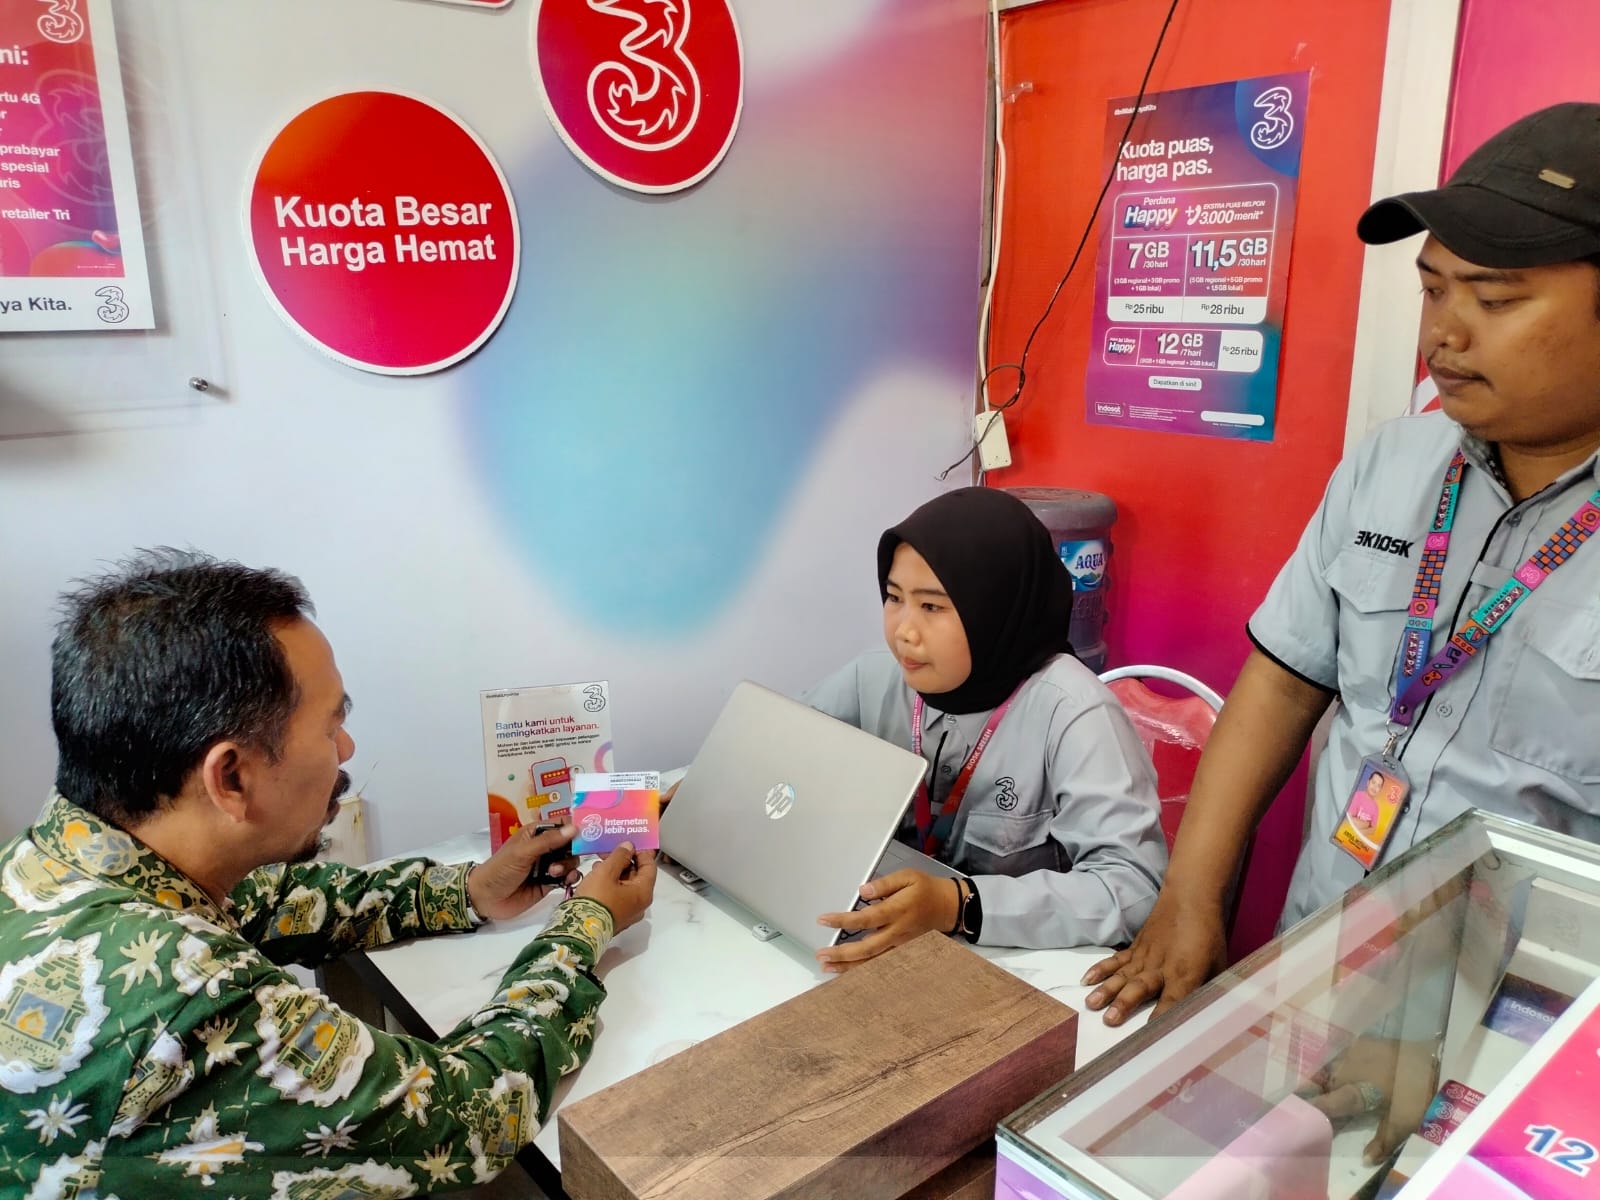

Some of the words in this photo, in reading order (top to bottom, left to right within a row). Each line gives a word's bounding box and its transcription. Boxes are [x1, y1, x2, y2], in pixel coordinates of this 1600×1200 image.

[21, 93, 41, 104] 4G
[0, 144, 60, 157] prabayar
[1168, 137, 1214, 159] puas,
[1, 162, 49, 173] spesial
[1116, 161, 1168, 183] harga
[1172, 158, 1212, 181] pas.
[2, 208, 50, 220] retailer
[52, 208, 70, 221] Tri
[274, 196, 386, 228] Kuota
[395, 195, 492, 227] Besar
[1124, 206, 1178, 226] Happy
[1199, 210, 1235, 225] 3.000
[281, 236, 386, 271] Harga
[395, 233, 496, 263] Hemat
[1144, 241, 1170, 258] GB
[1239, 237, 1268, 256] GB
[28, 297, 72, 311] Kita.
[1145, 304, 1164, 314] ribu
[1223, 304, 1245, 315] ribu
[1108, 341, 1136, 354] Happy
[1157, 333, 1181, 355] 12
[1181, 333, 1204, 348] GB
[1241, 347, 1259, 356] ribu
[1075, 553, 1103, 571] AQUA
[1484, 587, 1522, 627] HAPPY
[1404, 631, 1419, 676] HAPPY
[495, 721, 523, 731] Bantu
[525, 717, 547, 728] kami
[549, 715, 575, 726] untuk
[496, 725, 561, 739] meningkatkan
[562, 723, 600, 735] layanan.
[605, 818, 648, 826] Internetan
[604, 826, 625, 834] lebih
[626, 827, 650, 835] puas.
[1524, 1123, 1600, 1178] 12
